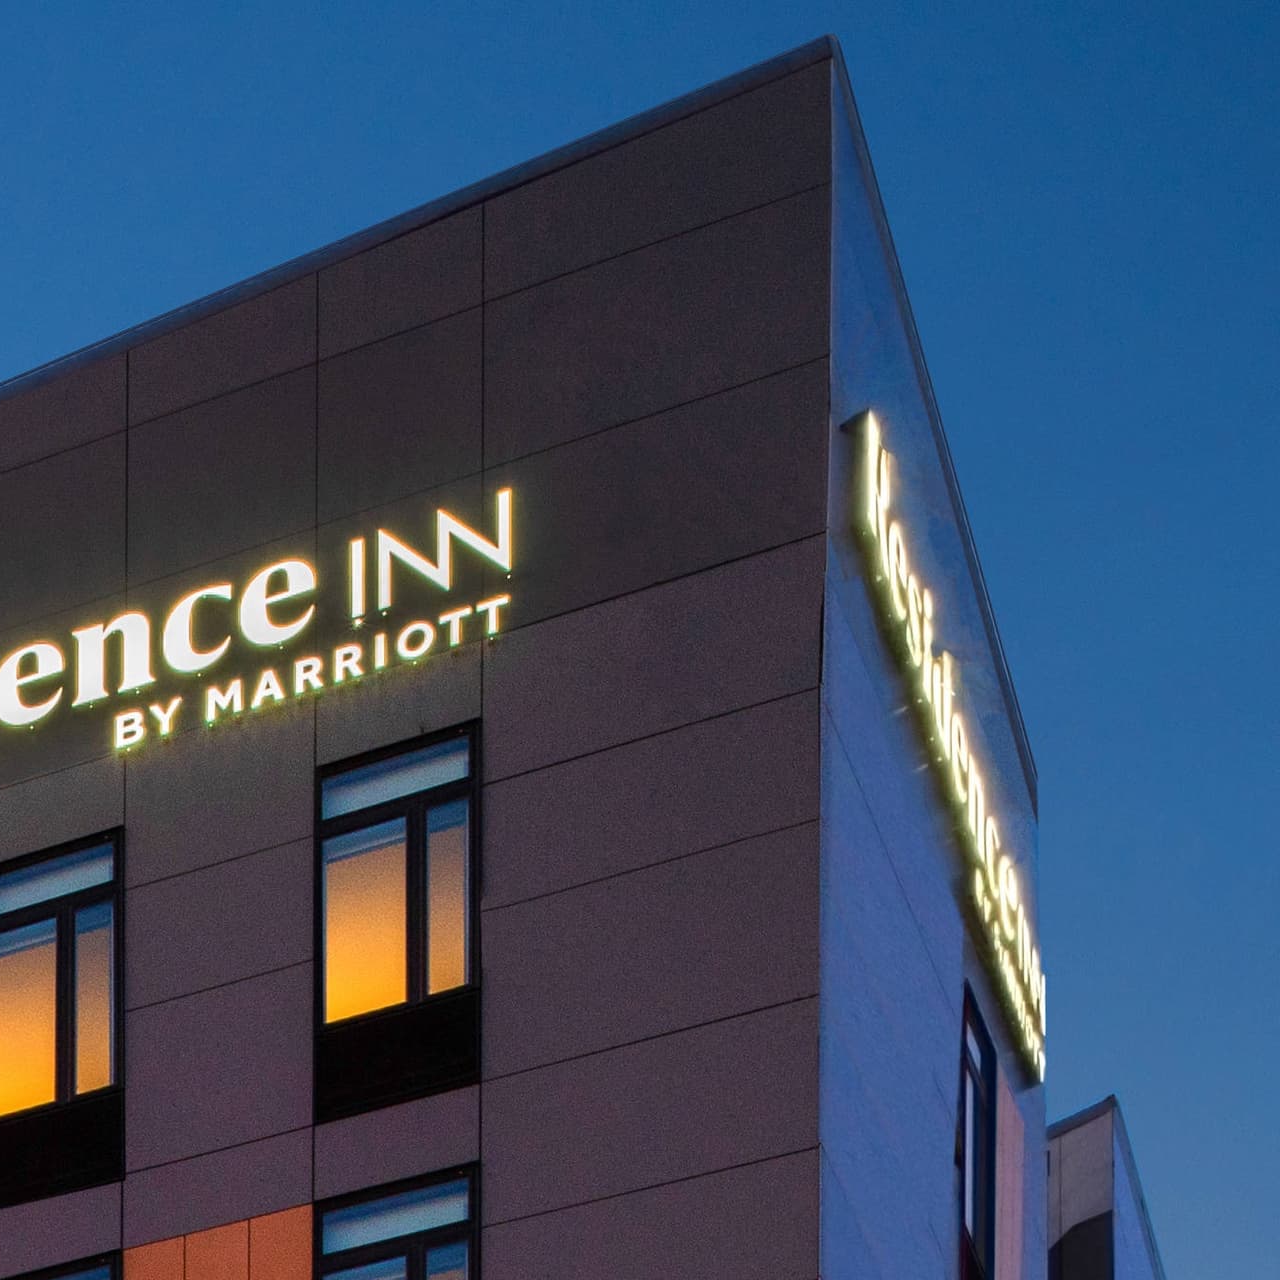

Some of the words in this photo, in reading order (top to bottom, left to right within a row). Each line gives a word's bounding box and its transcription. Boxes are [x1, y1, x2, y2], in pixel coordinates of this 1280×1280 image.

[350, 487, 512, 620] INN
[112, 696, 183, 751] BY
[204, 594, 511, 724] MARRIOTT
